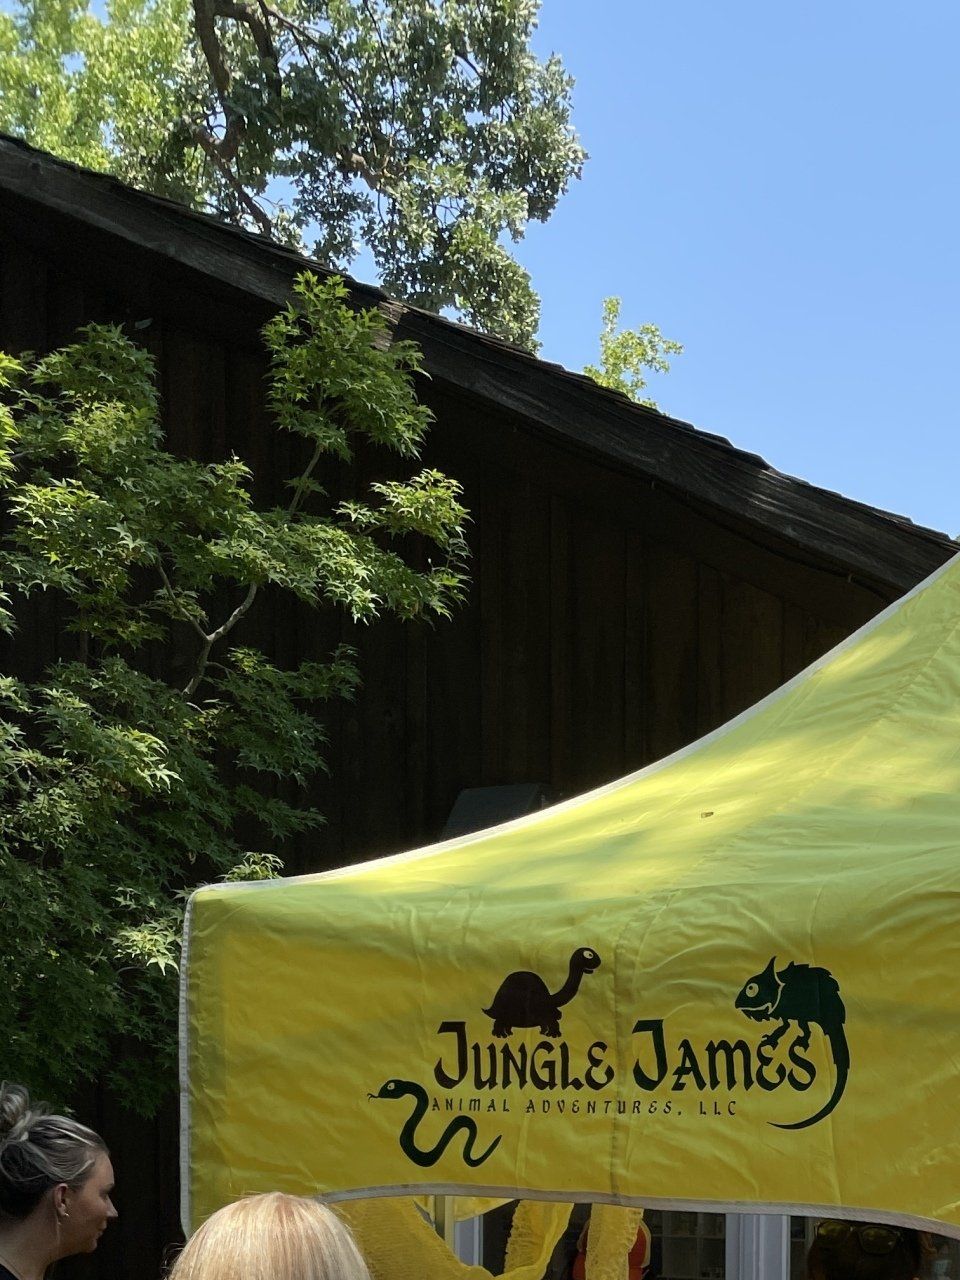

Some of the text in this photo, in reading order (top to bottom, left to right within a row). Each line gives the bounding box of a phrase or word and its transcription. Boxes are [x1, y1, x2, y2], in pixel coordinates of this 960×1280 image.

[434, 1019, 817, 1092] JUNGLE JAMES
[431, 1097, 737, 1117] ANIMAL ADVENTURES, LLC
